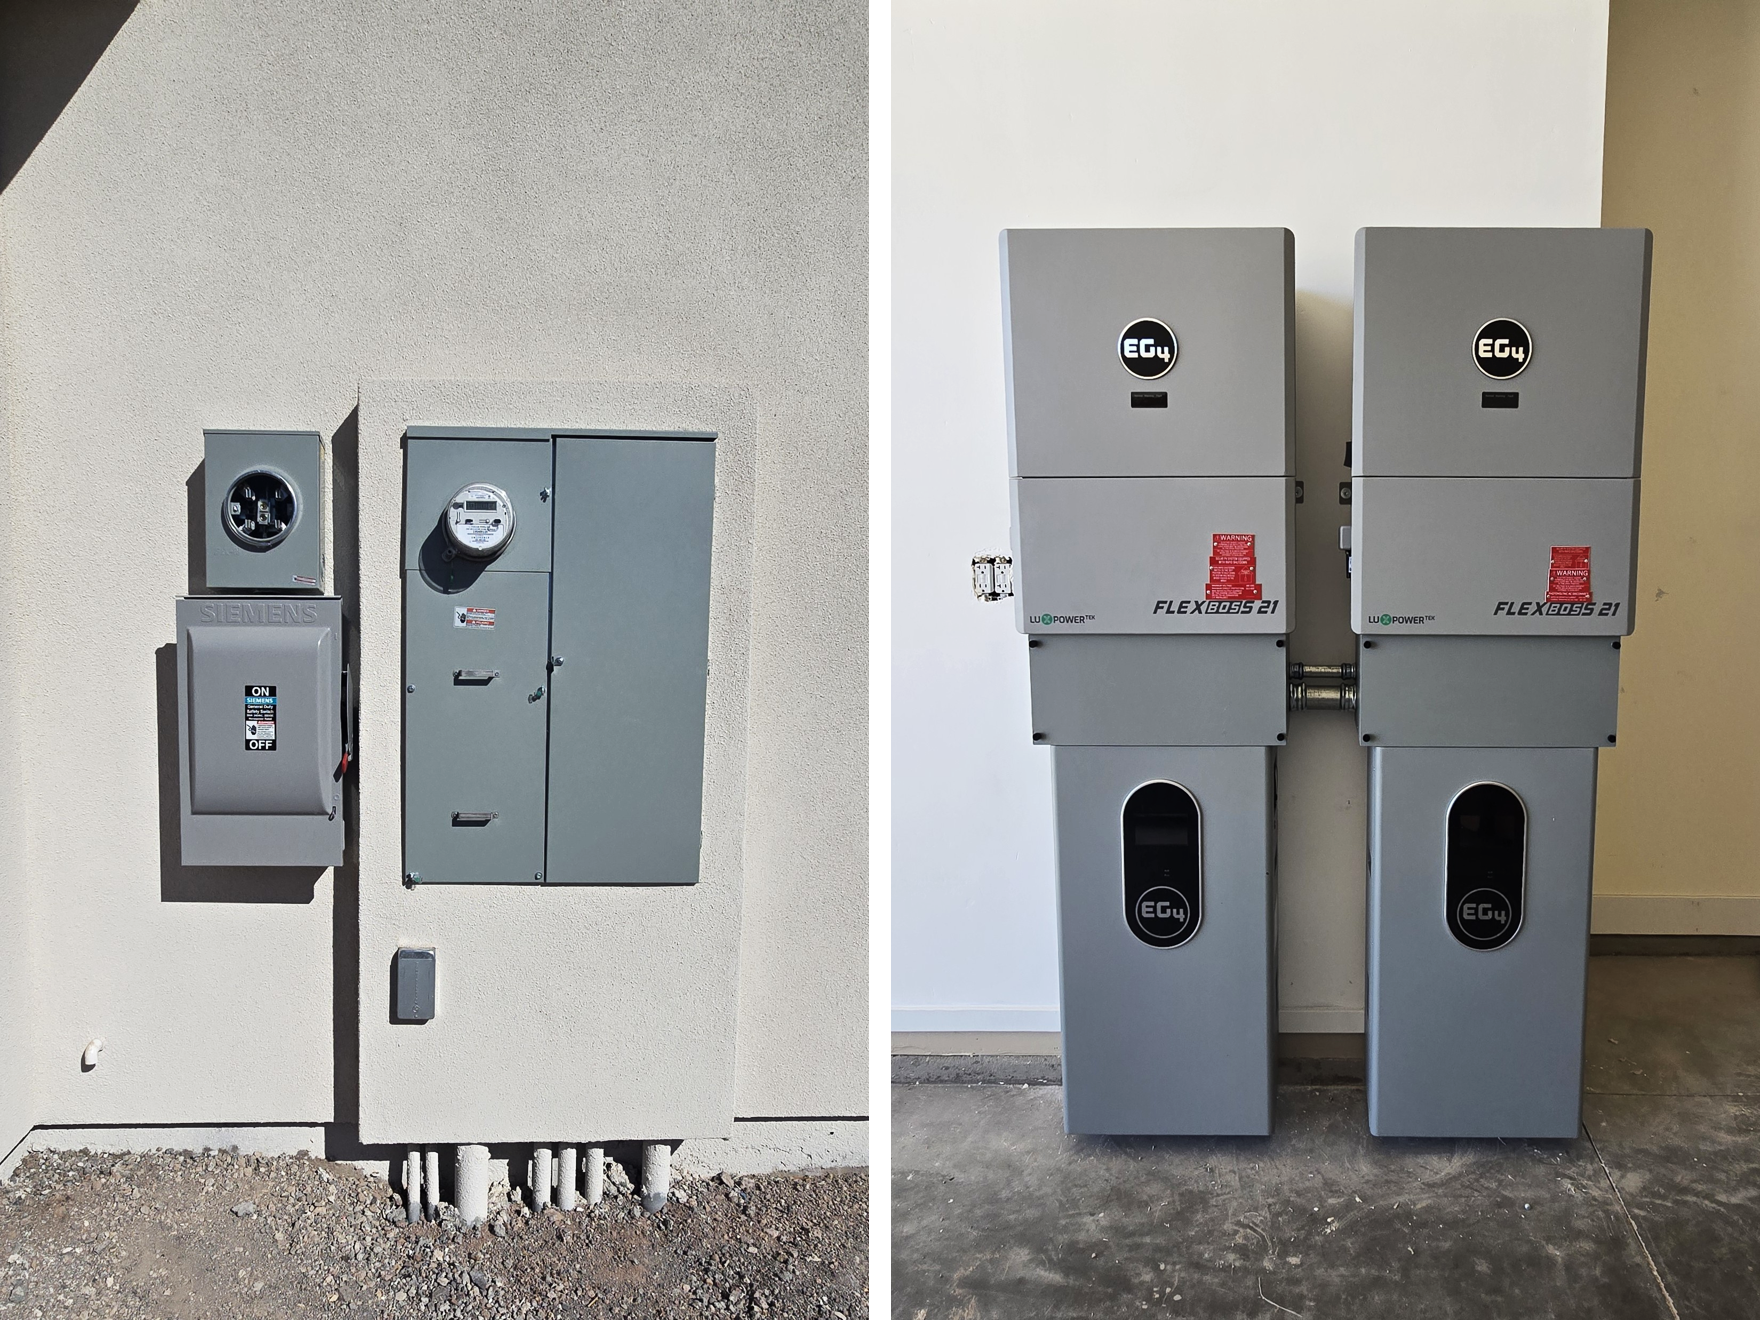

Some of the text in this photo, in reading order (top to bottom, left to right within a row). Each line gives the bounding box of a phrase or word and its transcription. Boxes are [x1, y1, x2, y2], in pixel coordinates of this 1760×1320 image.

[1123, 338, 1171, 363] EG4
[1478, 338, 1525, 363] EG4
[200, 602, 318, 624] SIEMENS
[1152, 600, 1279, 614] FLEXBOSS 21
[1493, 601, 1620, 616] FLEXBOSS 21
[251, 686, 269, 696] ON
[249, 739, 273, 750] OFF
[1141, 901, 1185, 922] EG4
[1463, 903, 1507, 924] EG4
